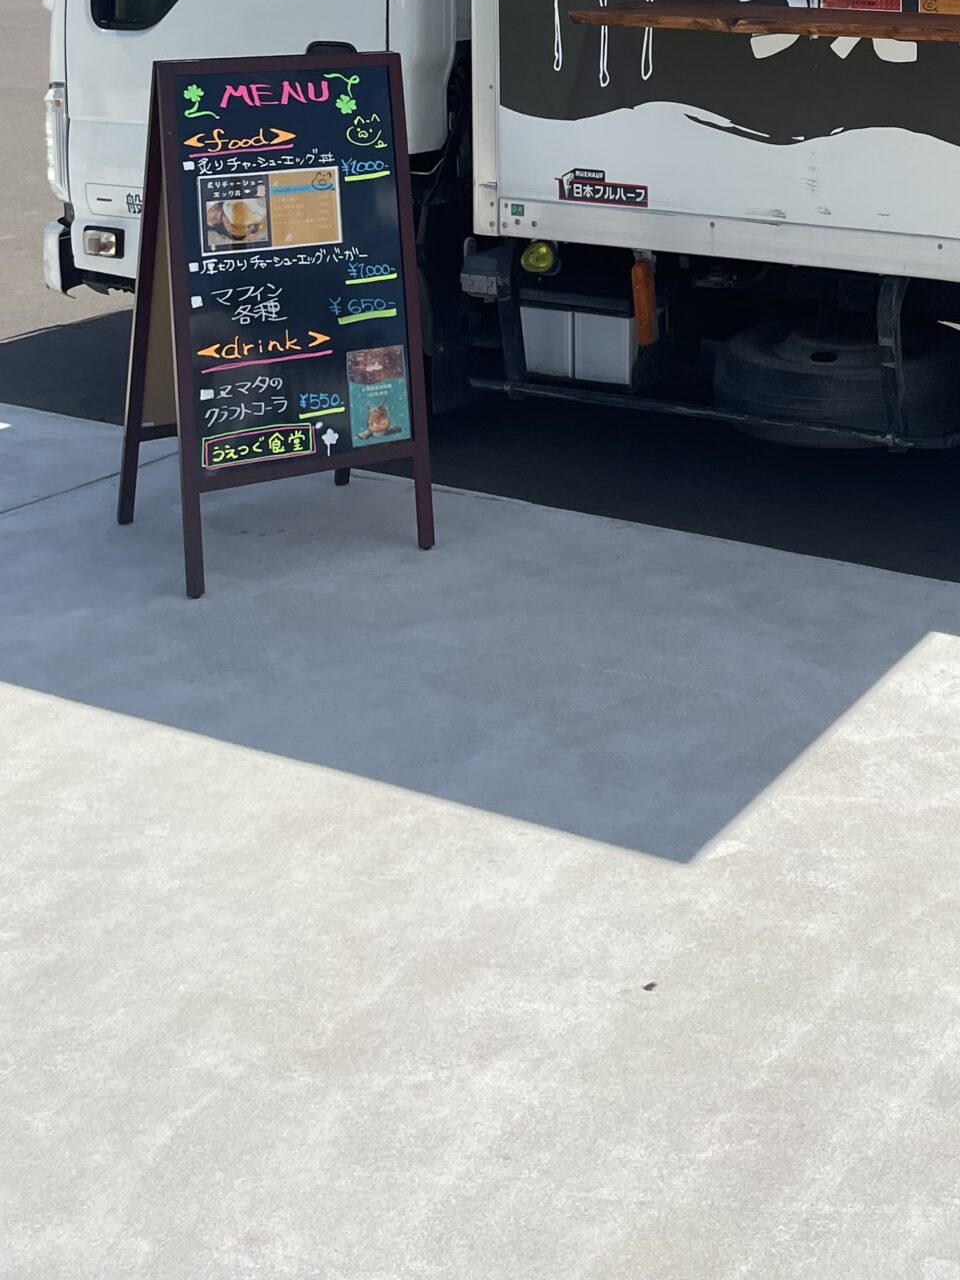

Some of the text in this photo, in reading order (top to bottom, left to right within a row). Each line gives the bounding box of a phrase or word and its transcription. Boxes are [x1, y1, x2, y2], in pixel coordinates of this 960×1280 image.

[219, 80, 330, 108] MENU
[573, 183, 645, 201] 日本フルハーフ
[200, 247, 368, 275] 厚切りチャーシューエッグバーガー
[210, 283, 283, 306] マフィン
[231, 298, 287, 325] 各種
[204, 397, 288, 428] クラフトコーラ
[212, 430, 306, 462] うえつぐ食堂
